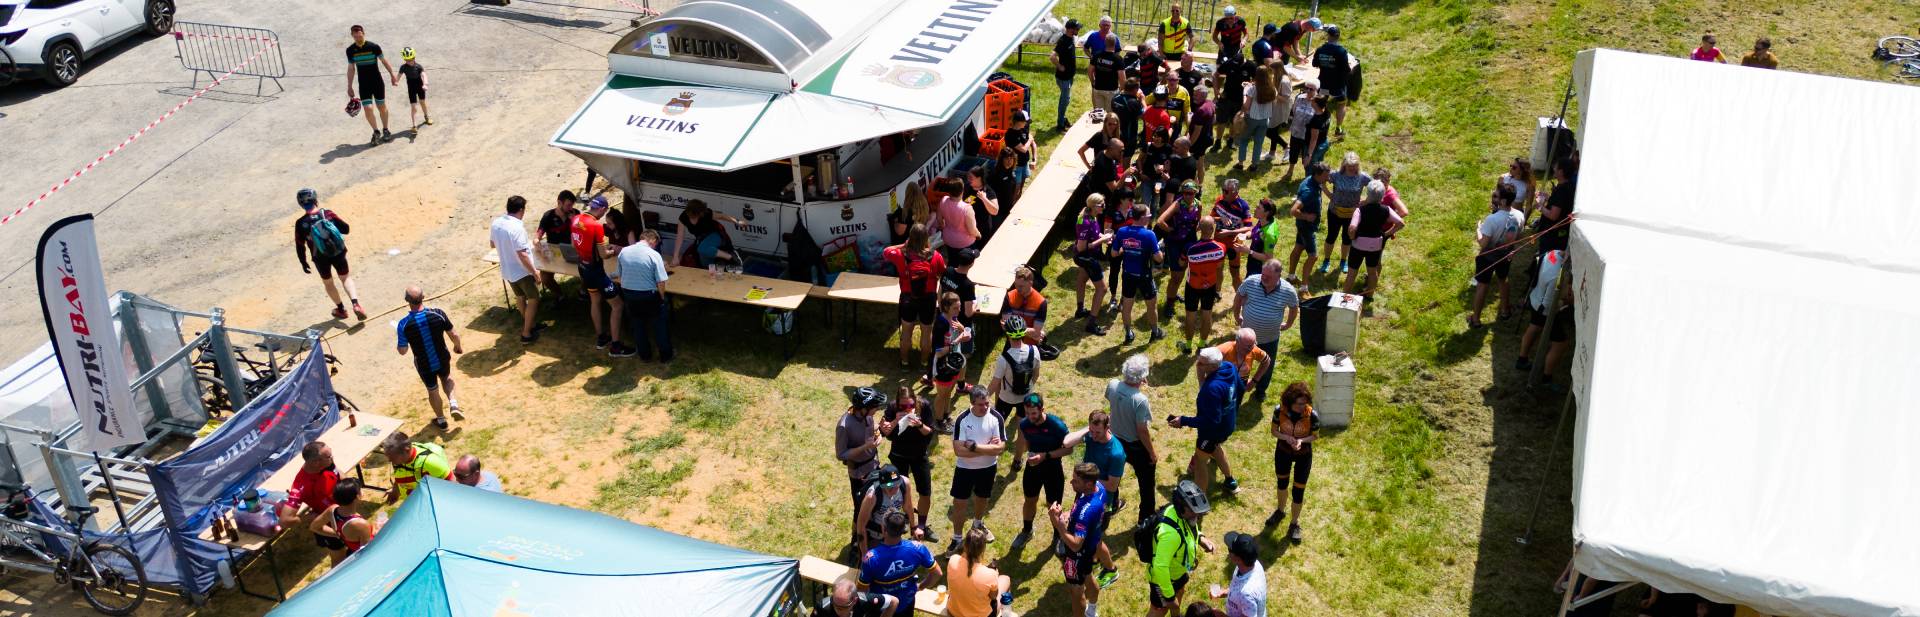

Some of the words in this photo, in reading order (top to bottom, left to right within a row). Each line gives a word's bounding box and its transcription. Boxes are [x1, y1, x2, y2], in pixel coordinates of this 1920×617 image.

[889, 0, 1000, 64] VELTIN
[670, 36, 739, 61] VELTINS
[626, 114, 700, 134] VELTINS
[926, 129, 962, 185] VELTINS
[829, 222, 867, 235] VELTINS
